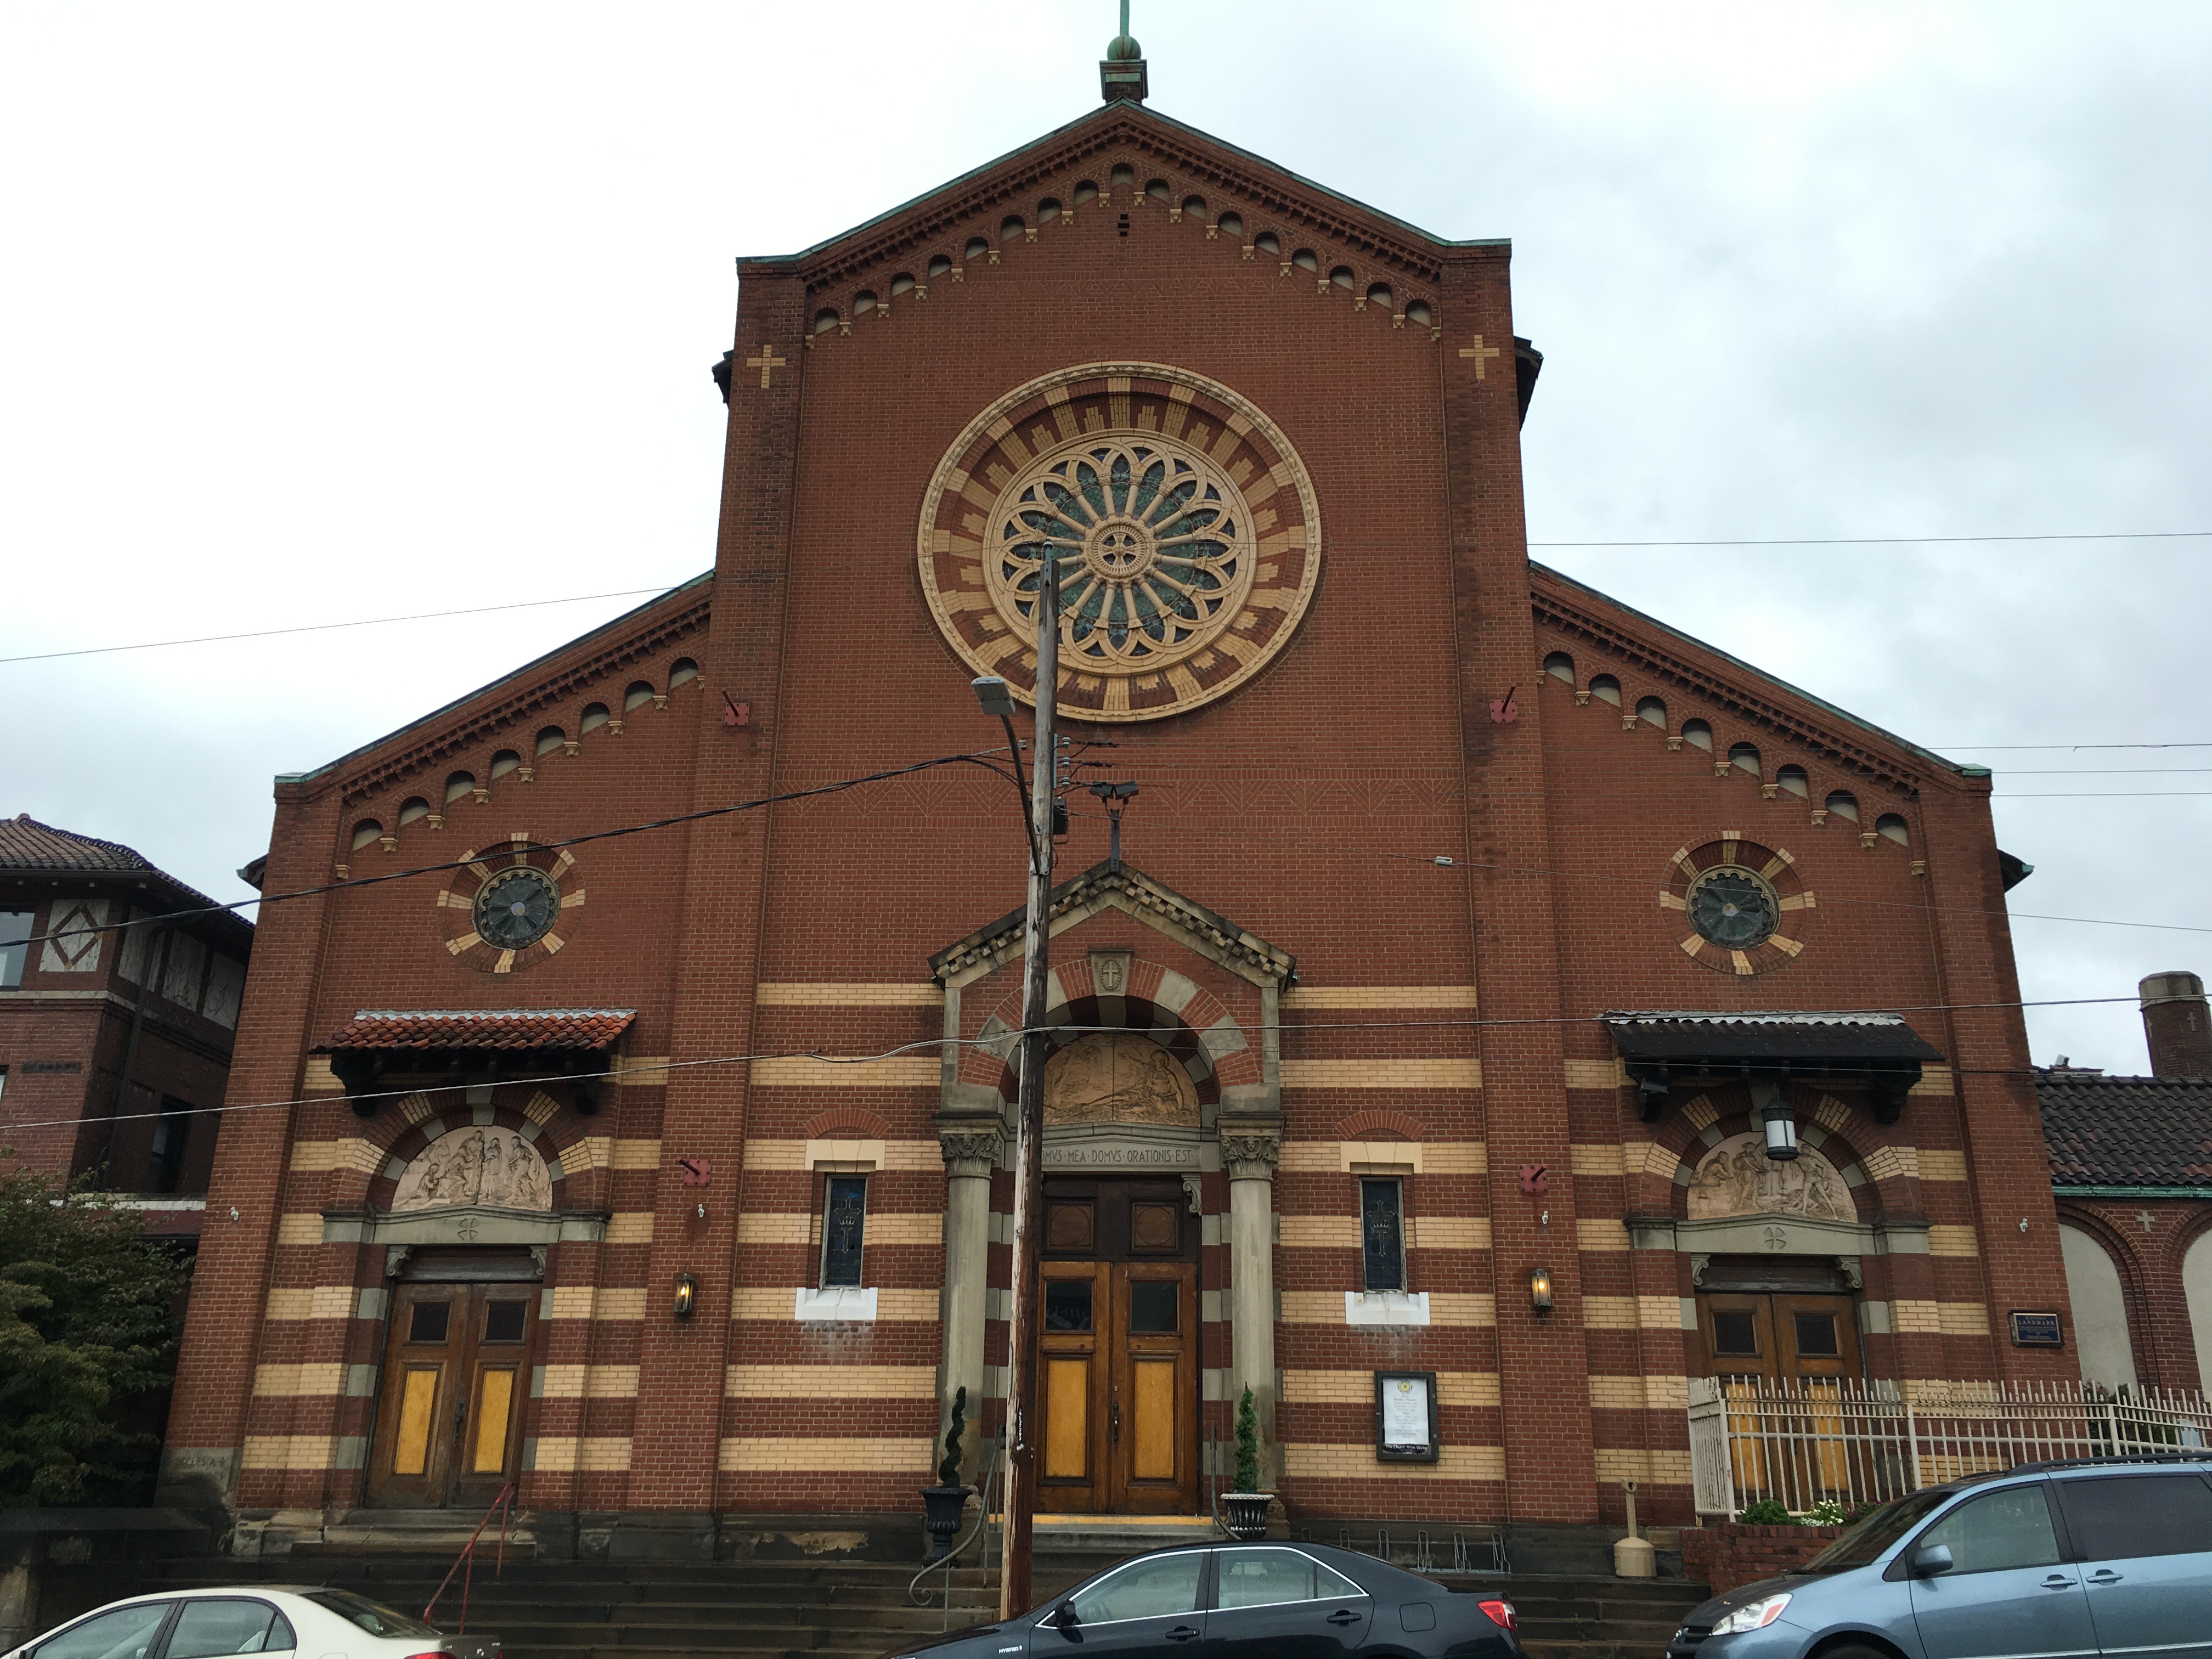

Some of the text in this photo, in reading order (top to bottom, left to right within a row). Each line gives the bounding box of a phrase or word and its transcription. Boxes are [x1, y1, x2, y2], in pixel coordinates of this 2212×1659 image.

[1068, 1149, 1087, 1163] MEA
[1092, 1149, 1121, 1163] DOMVS
[1127, 1149, 1171, 1163] ORATIONIS
[1176, 1149, 1192, 1163] EST
